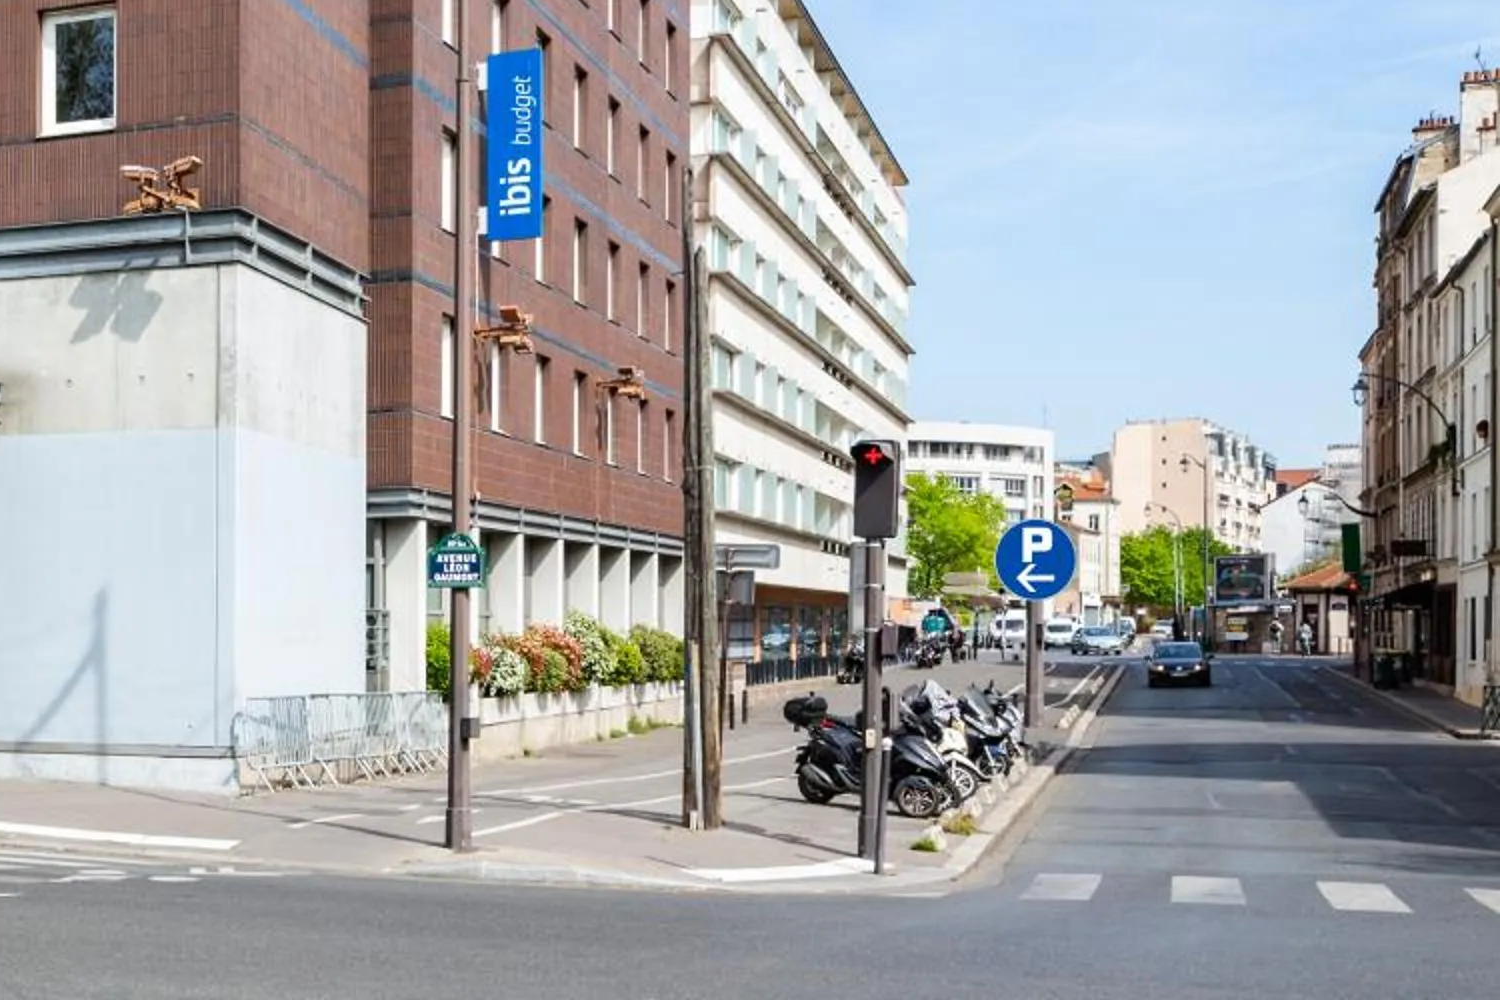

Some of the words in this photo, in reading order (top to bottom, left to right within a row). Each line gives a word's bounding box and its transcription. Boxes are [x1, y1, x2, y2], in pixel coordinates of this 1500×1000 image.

[510, 75, 537, 145] budget
[499, 157, 532, 216] ibis
[436, 553, 477, 563] AVENUE
[1022, 527, 1053, 562] P
